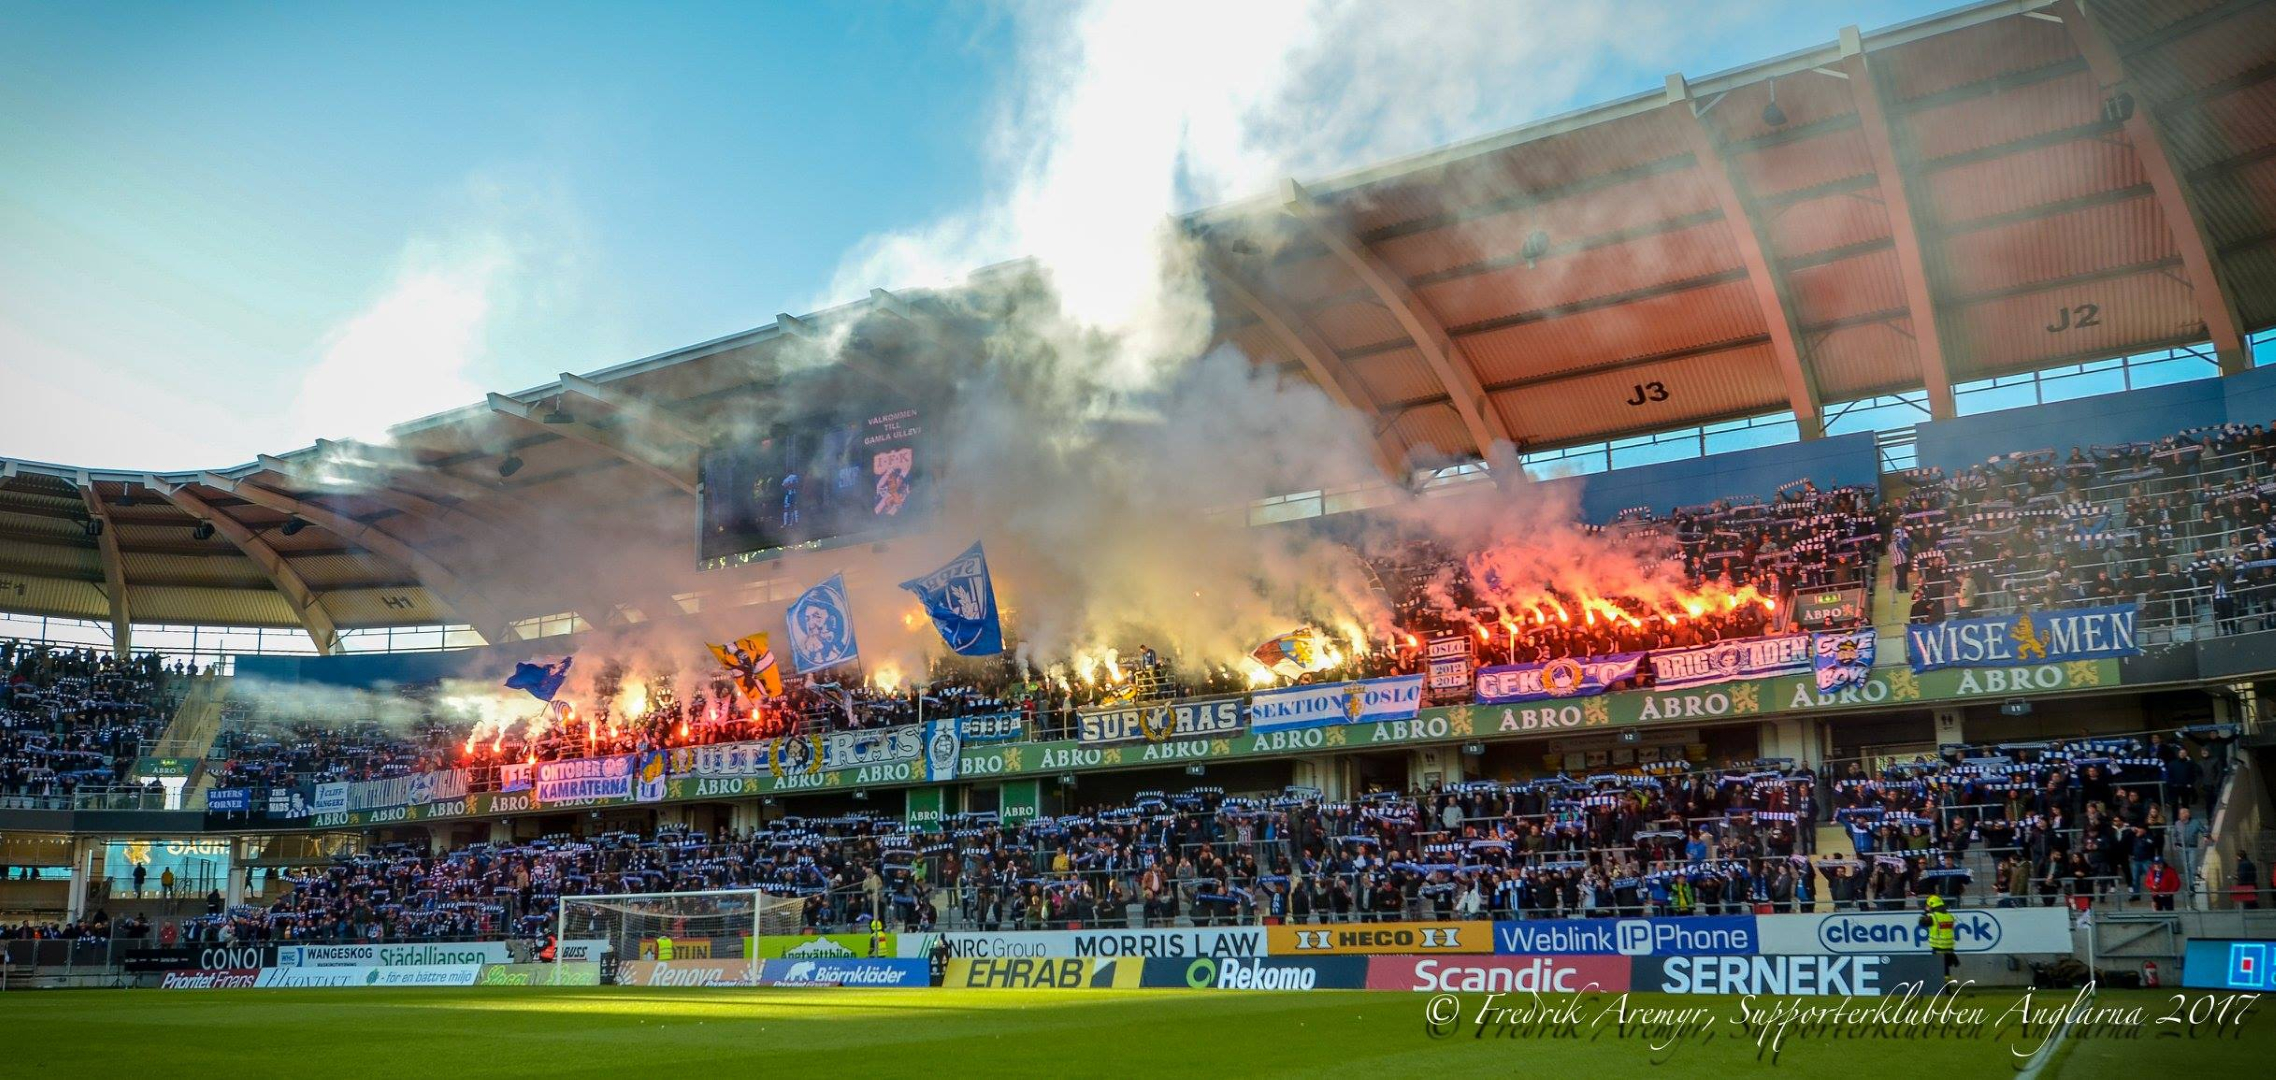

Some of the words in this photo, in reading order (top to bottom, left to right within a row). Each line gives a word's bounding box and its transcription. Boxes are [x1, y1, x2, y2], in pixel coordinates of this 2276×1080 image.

[2047, 304, 2101, 333] J2
[1626, 382, 1669, 406] J3
[864, 434, 891, 445] GAMLA
[893, 427, 921, 439] ULLEVI
[1432, 643, 1463, 655] OSLO
[1913, 620, 2011, 665] WISE
[2051, 611, 2135, 655] MEN
[1653, 652, 1710, 680] BRIG
[1436, 676, 1461, 686] 2017
[1957, 664, 2063, 695] ÅBRO
[1252, 694, 1343, 719] SEKTION
[1365, 685, 1420, 705] OSLO
[1639, 693, 1730, 721] ÅBRO
[1499, 705, 1582, 731] ÅBRO
[828, 726, 923, 768] RAS
[210, 789, 243, 799] HATERS
[539, 778, 628, 800] KAMRATERNA
[209, 800, 242, 809] CORNER
[1339, 930, 1413, 946] HECO
[1502, 926, 1613, 953] Weblink
[1622, 925, 1648, 950] IP
[1655, 923, 1749, 950] Phone
[1826, 918, 1907, 943] clean
[1914, 915, 1993, 948] prk
[307, 947, 373, 960] WANGESKOG
[380, 945, 486, 966] Städalliansen
[948, 939, 988, 958] NRC
[992, 938, 1047, 958] Group
[1075, 934, 1185, 957] MORRIS
[1195, 932, 1260, 957] LAW
[161, 971, 216, 989] Prioritet
[213, 970, 255, 989] Finans
[401, 973, 413, 983] en
[648, 961, 725, 987] Renova
[1217, 957, 1316, 991] Rekomo
[1412, 958, 1577, 993] Scandic
